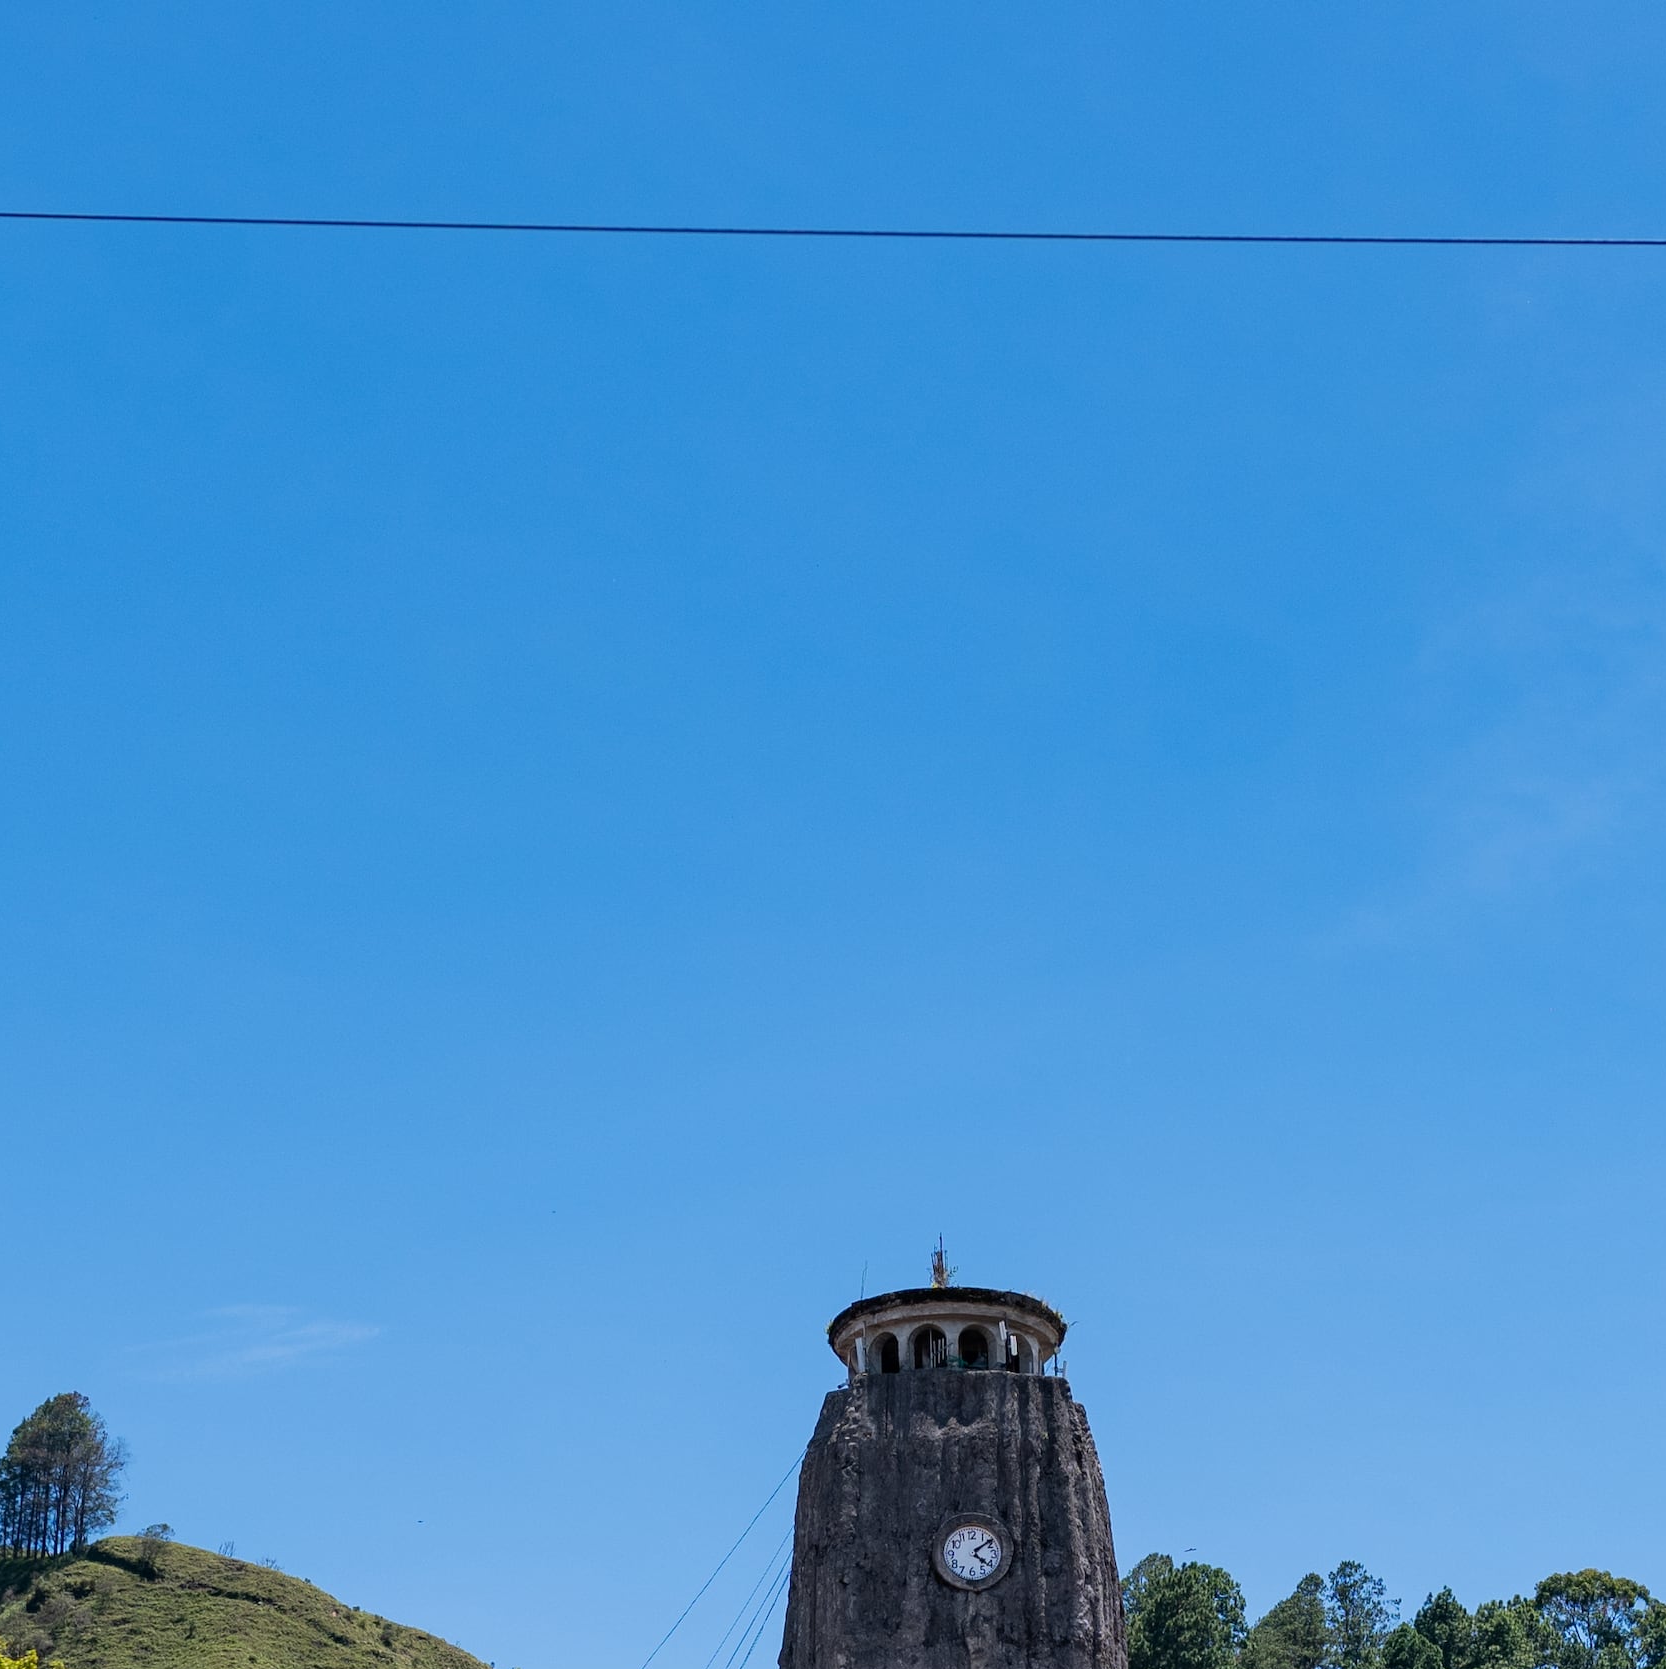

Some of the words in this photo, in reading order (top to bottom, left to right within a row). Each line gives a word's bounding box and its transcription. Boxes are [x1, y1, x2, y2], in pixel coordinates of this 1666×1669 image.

[958, 1531, 965, 1542] 11
[968, 1530, 976, 1540] 12
[952, 1540, 961, 1549] 10
[948, 1550, 954, 1559] 9
[990, 1549, 997, 1558] 3
[952, 1559, 958, 1568] 8
[986, 1560, 993, 1568] 4
[969, 1567, 976, 1576] 6
[980, 1565, 985, 1574] 5
